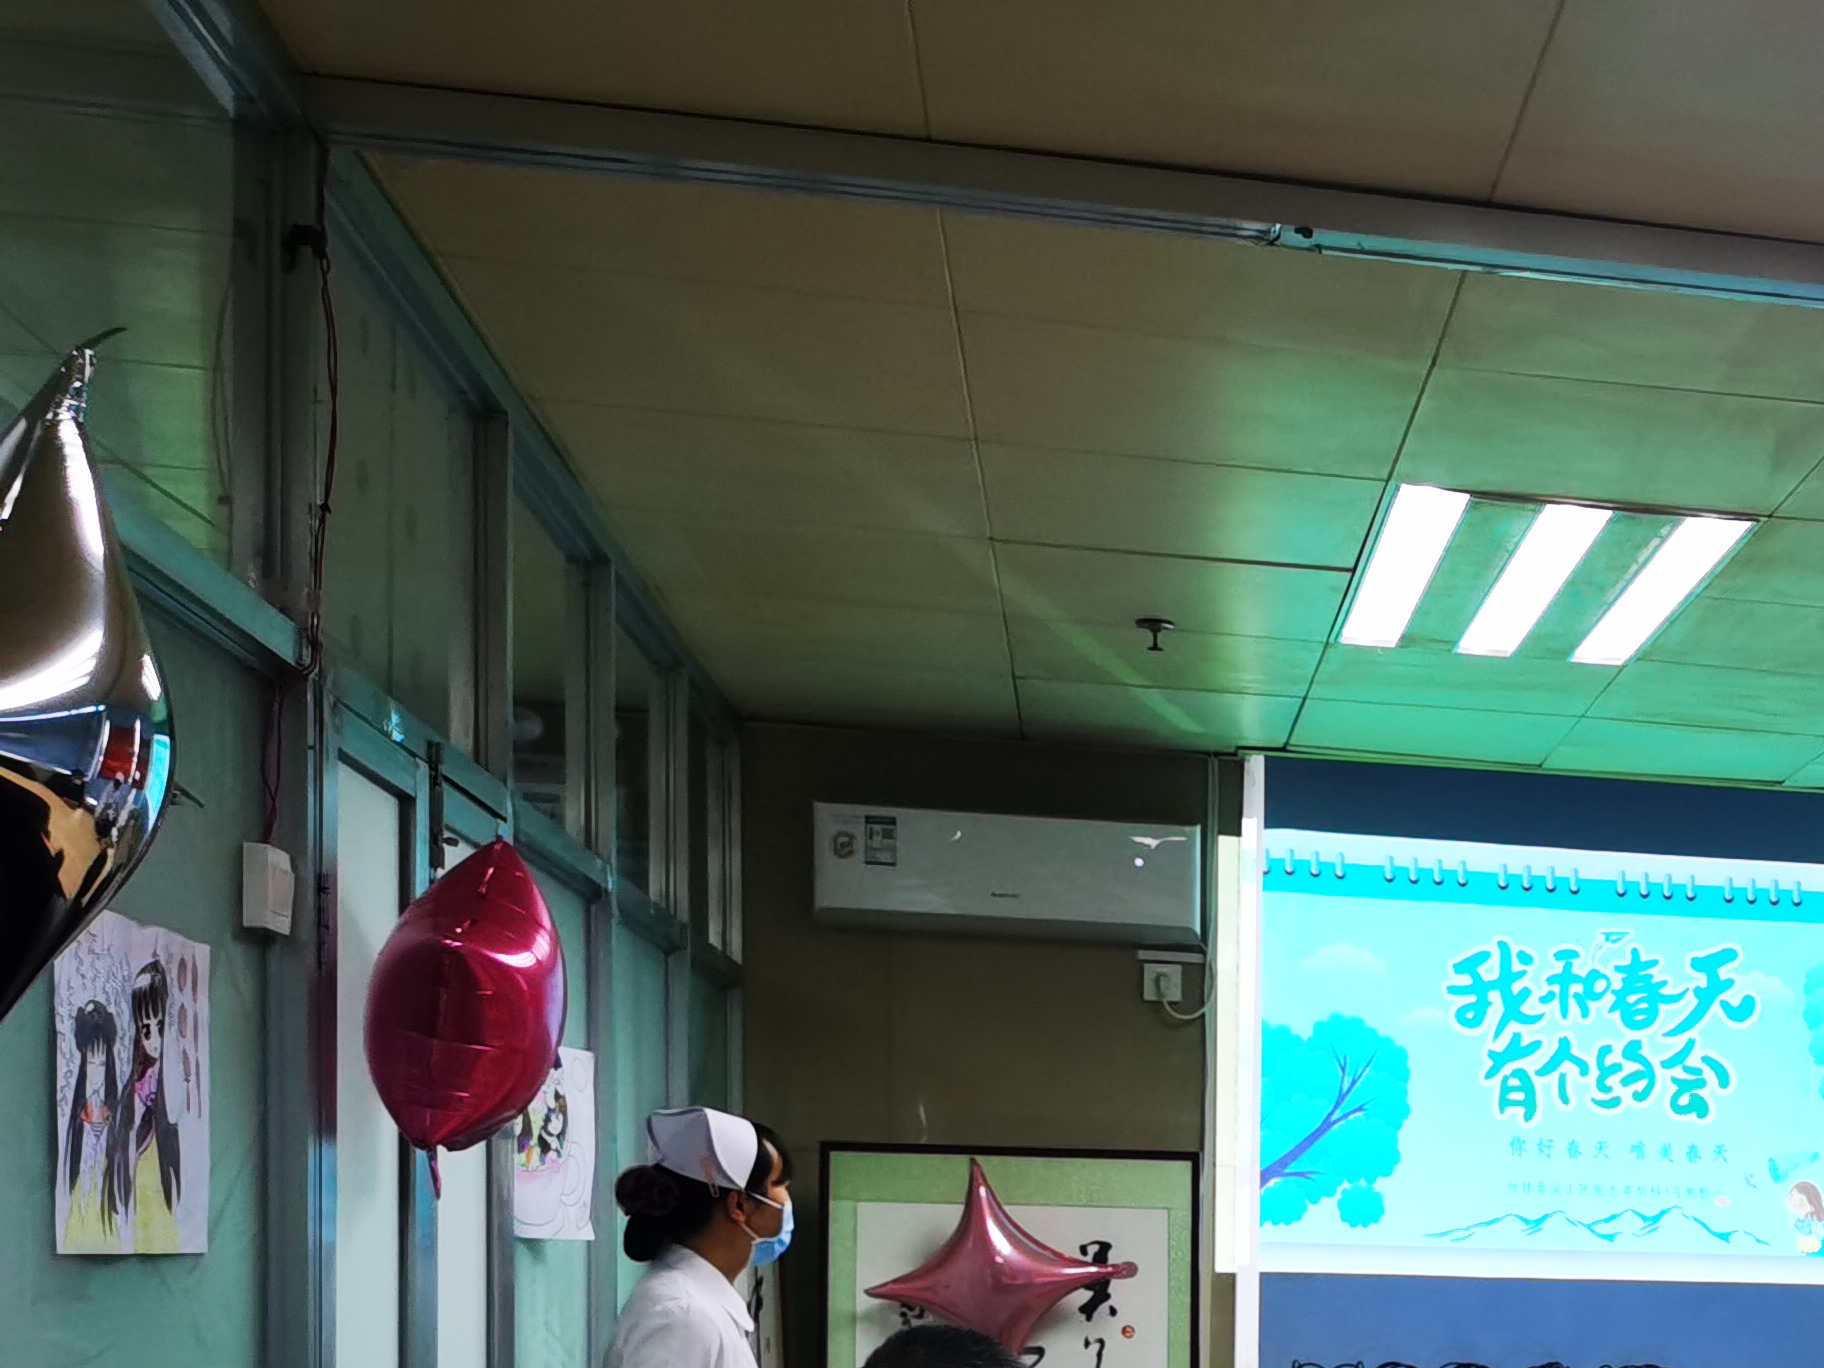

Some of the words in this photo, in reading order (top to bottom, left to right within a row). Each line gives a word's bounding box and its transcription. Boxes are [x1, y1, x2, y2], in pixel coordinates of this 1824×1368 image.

[1446, 940, 1756, 1042] 我和春天
[1484, 1032, 1731, 1123] 有个约会
[1509, 1135, 1611, 1160] 你好春天
